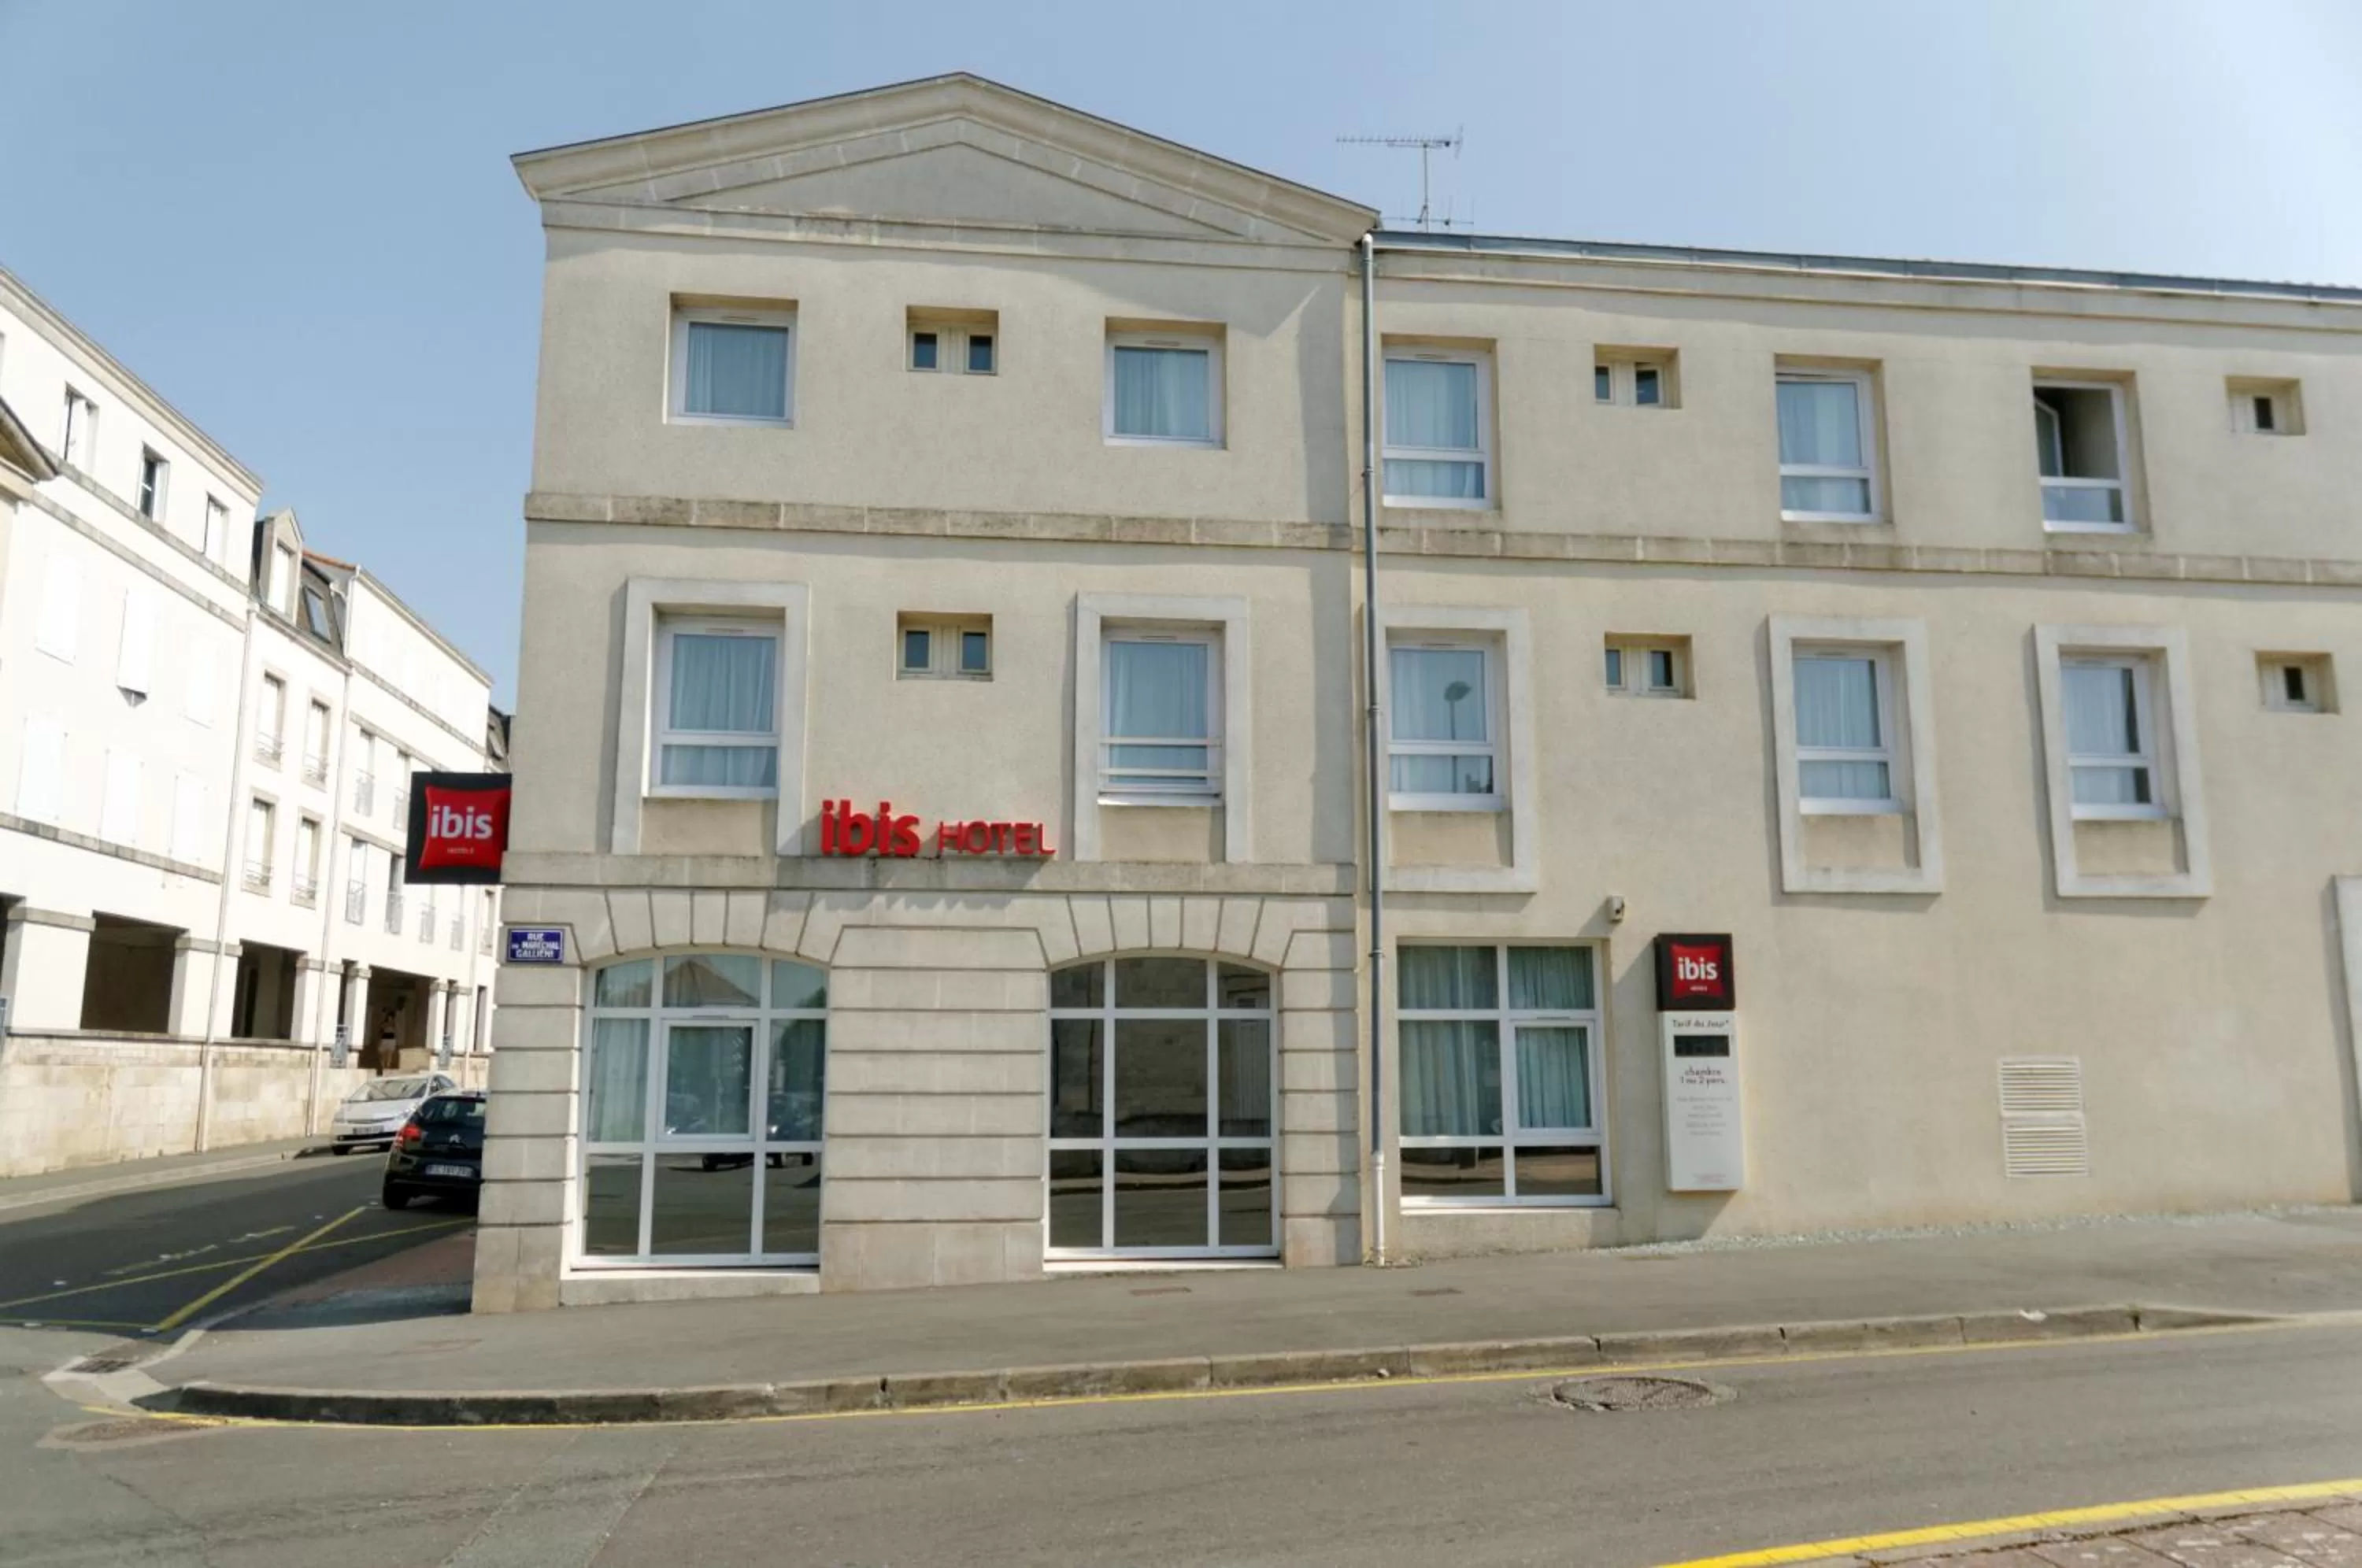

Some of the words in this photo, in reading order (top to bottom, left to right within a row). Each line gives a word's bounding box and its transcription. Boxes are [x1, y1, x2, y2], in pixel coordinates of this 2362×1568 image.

[431, 805, 493, 839] ibis
[820, 800, 920, 856] ibis
[938, 820, 1056, 855] HOTEL
[516, 949, 553, 958] GALLIENI
[1678, 956, 1718, 981] ibis
